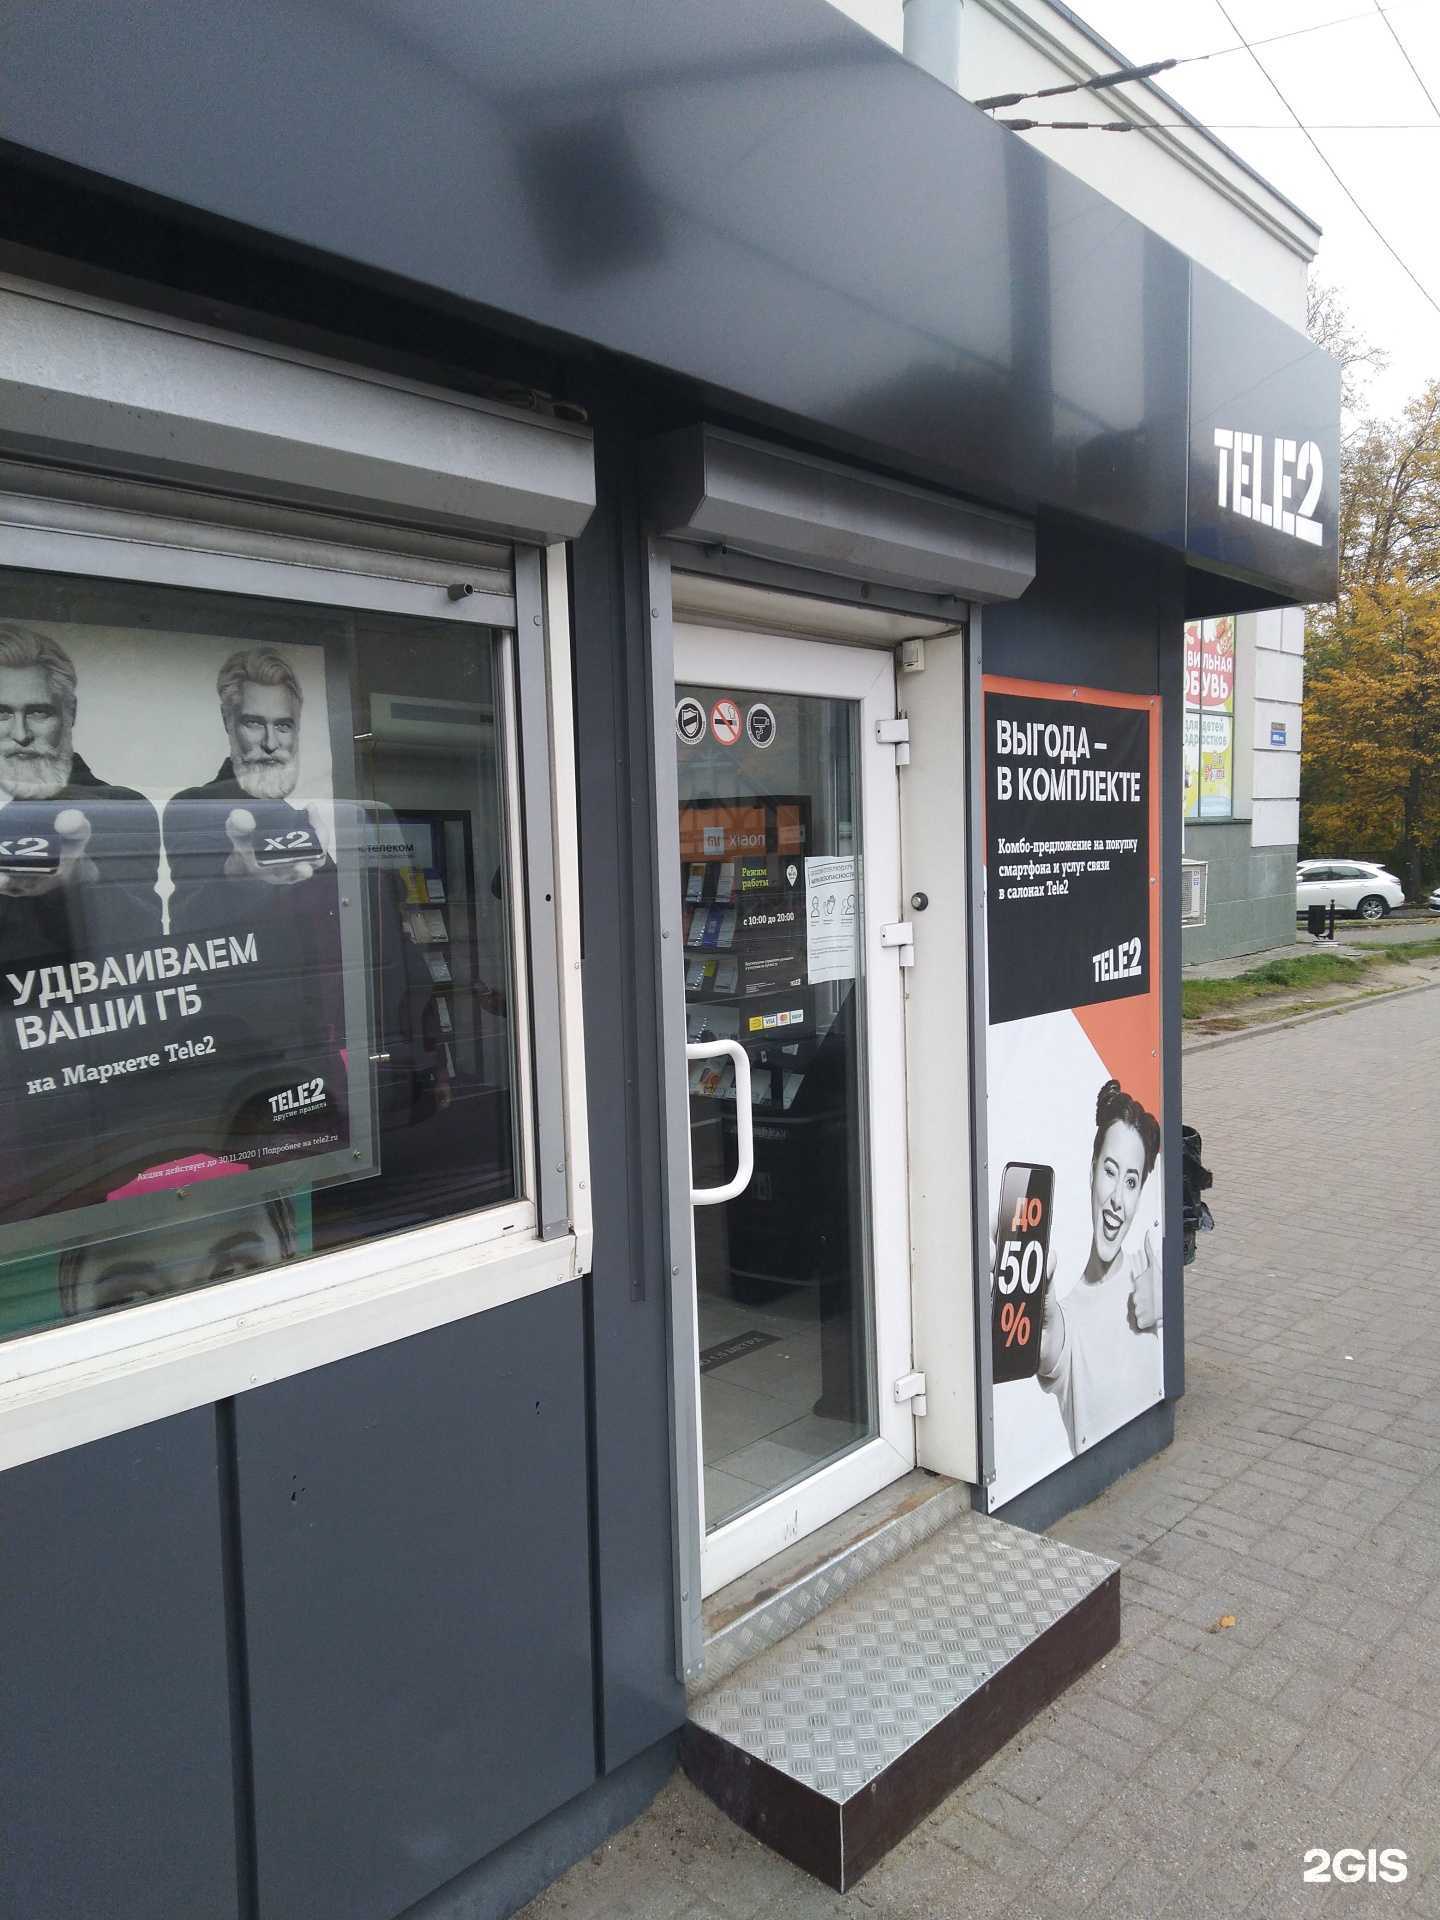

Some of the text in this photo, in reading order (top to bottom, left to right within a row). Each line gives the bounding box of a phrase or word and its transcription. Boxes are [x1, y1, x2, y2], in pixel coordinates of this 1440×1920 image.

[1214, 428, 1323, 546] TELE2
[996, 719, 1090, 765] ВЫГОДА
[997, 766, 1141, 802] В КОМПЛЕКТЕ
[998, 837, 1138, 856] Комбо-предложение на покупку
[742, 867, 768, 877] Режим
[742, 879, 769, 890] работы
[999, 860, 1110, 880] смартфона и услуг связи
[999, 879, 1069, 899] в салонах Tele2
[748, 914, 766, 925] 10:00
[767, 916, 776, 924] до
[776, 912, 794, 922] 20:00
[6, 933, 259, 1008] УДВАИВАЕМ
[1092, 936, 1142, 983] TELE2
[15, 984, 203, 1050] ВАШИ ГБ
[26, 1035, 217, 1095] на Маркете Tele2
[268, 1077, 326, 1114] TELE2
[165, 1161, 206, 1177] действует
[207, 1159, 217, 1168] до
[218, 1149, 256, 1165] 30.11.2020
[262, 1141, 301, 1156] Подробнее
[302, 1138, 312, 1147] на
[313, 1134, 338, 1145] tele2.ru
[998, 1240, 1044, 1295] 50
[1001, 1302, 1031, 1348] %
